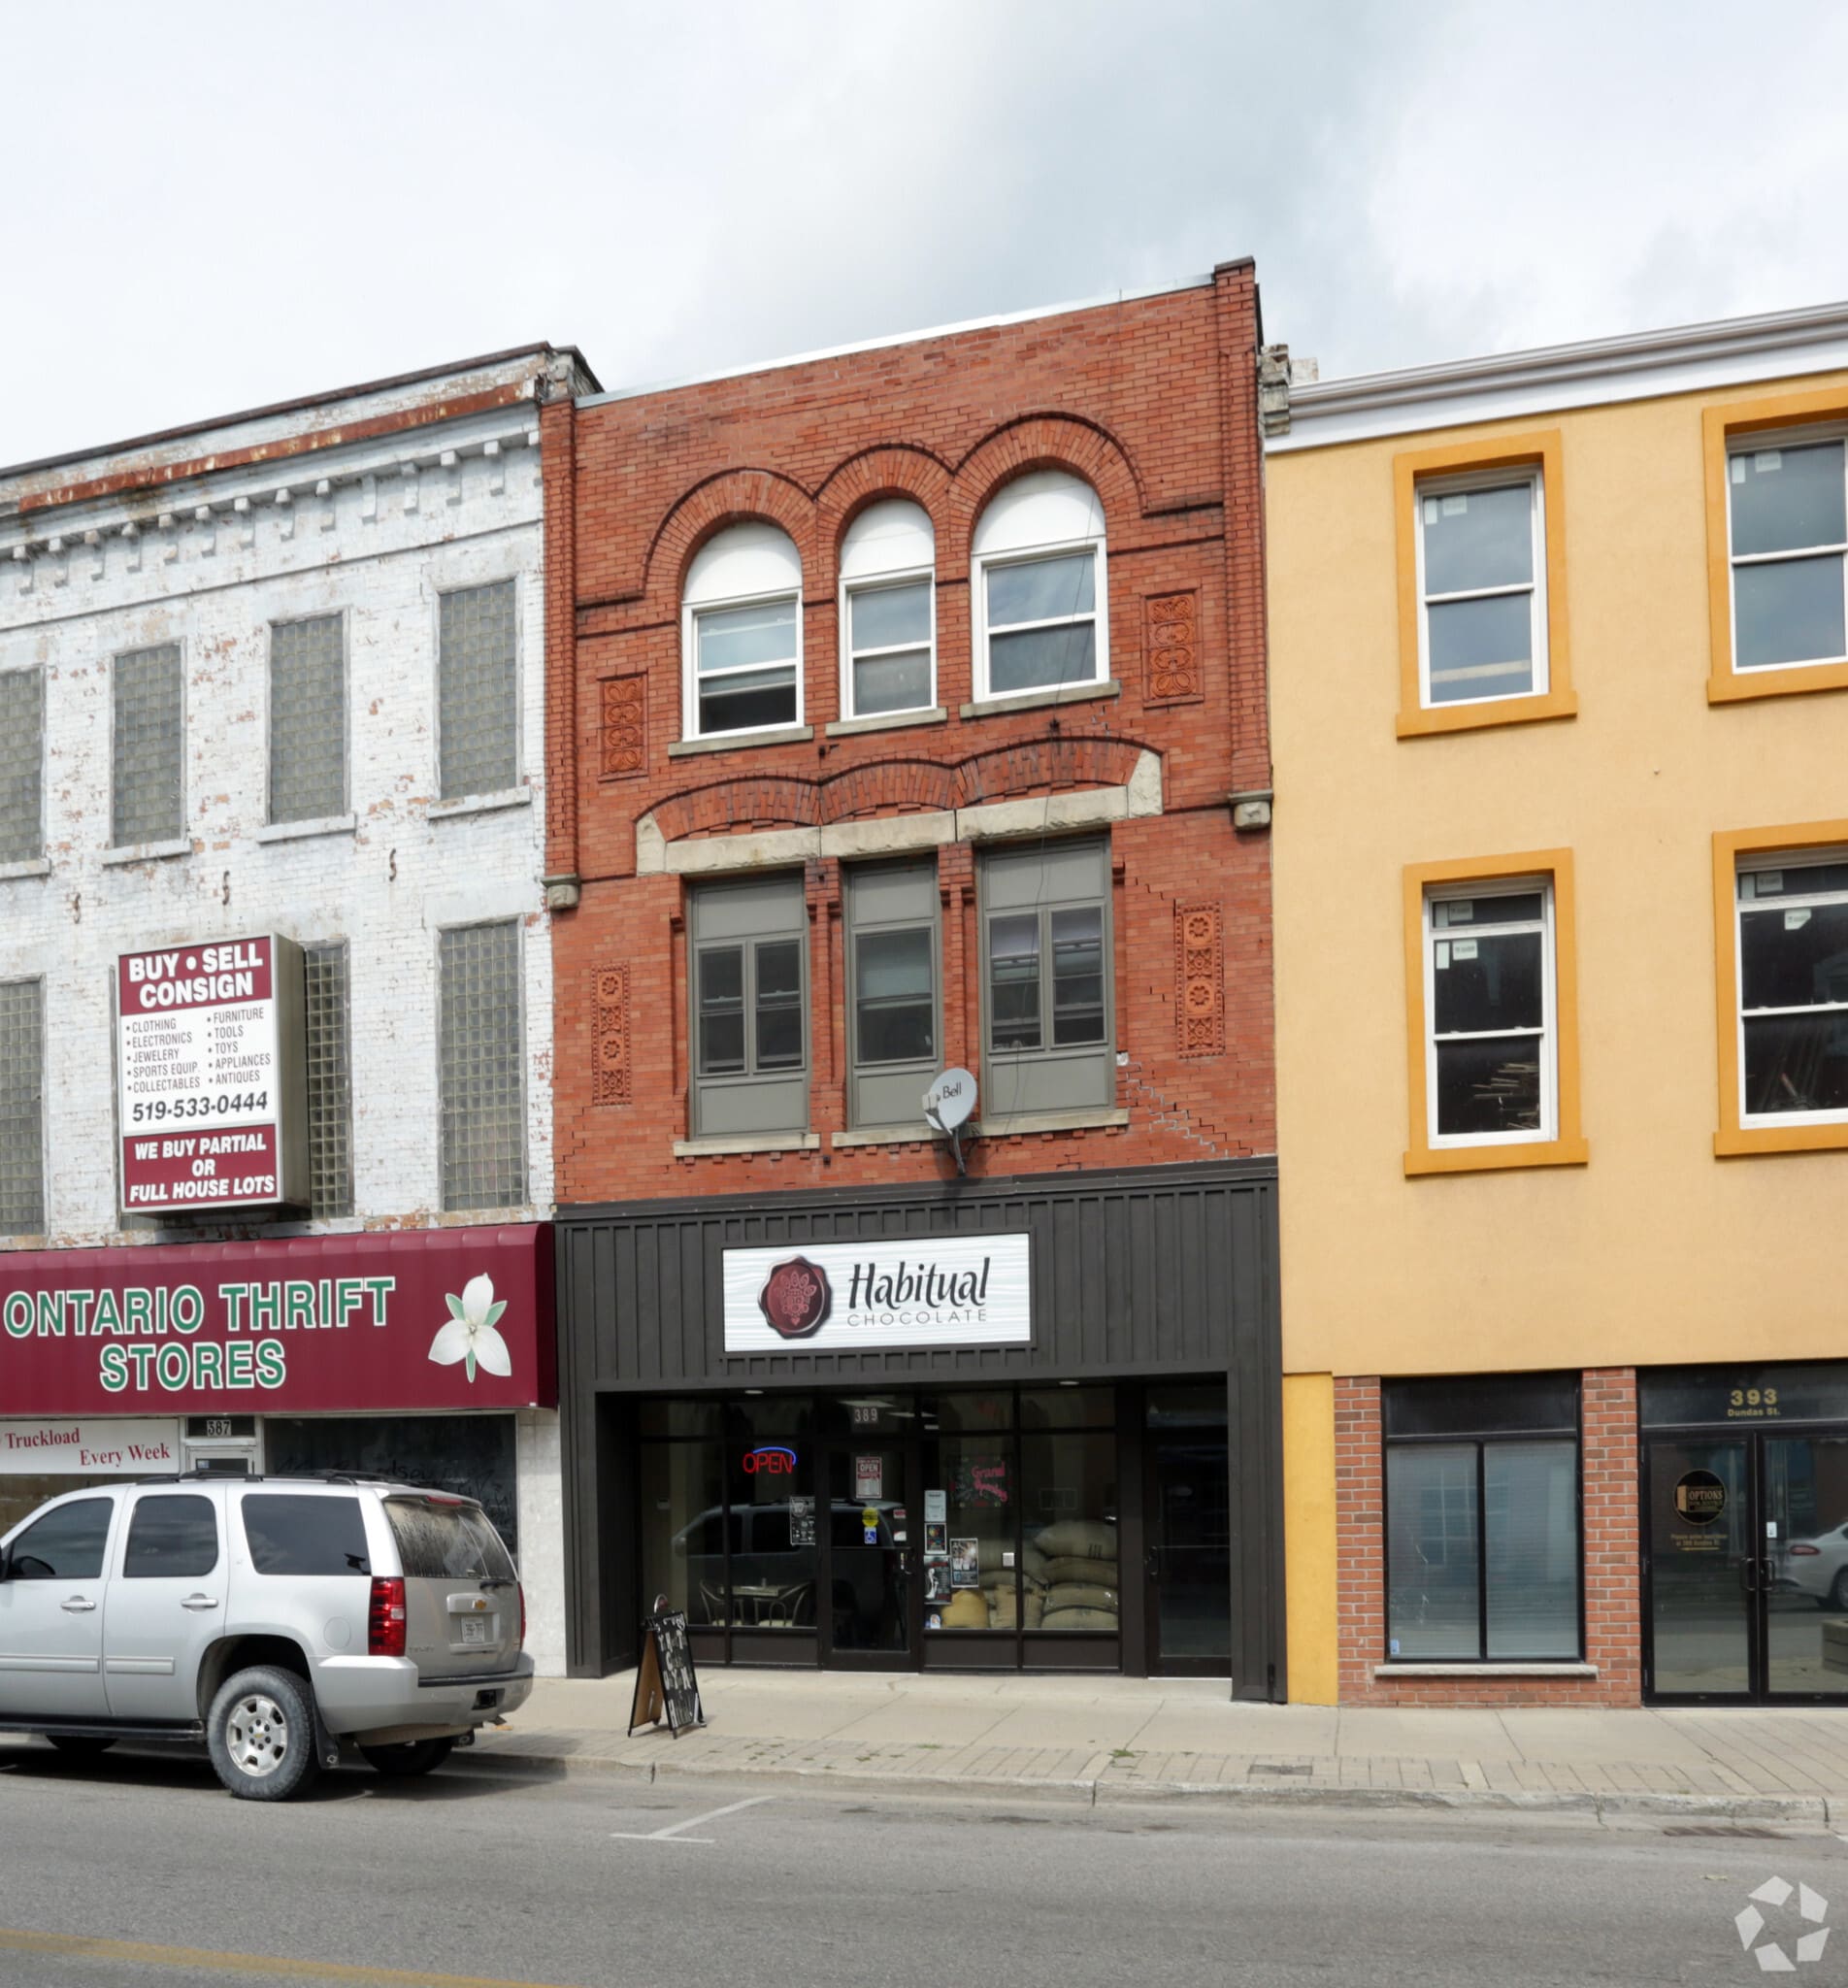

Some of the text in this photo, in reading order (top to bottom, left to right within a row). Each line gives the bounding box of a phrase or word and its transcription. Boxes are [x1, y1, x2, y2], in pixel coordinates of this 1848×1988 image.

[128, 943, 263, 982] BUY SELL
[139, 972, 253, 1009] CONSIGN
[214, 1007, 264, 1024] FURNITURE
[132, 1017, 177, 1034] CLOTHING
[214, 1025, 244, 1040] TOOLS
[132, 1031, 192, 1048] ELECTRONICS
[215, 1041, 239, 1054] TOYS
[133, 1048, 180, 1063] JEWELERY
[215, 1052, 271, 1070] APPLIANCES
[133, 1064, 168, 1078] SPORTS
[215, 1070, 260, 1085] ANTIQUES
[133, 1076, 200, 1093] COLLECTABLES
[942, 1080, 962, 1099] Bell
[132, 1090, 268, 1122] 519-533-0444
[135, 1133, 267, 1160] WE BUY PARTIAL
[192, 1158, 215, 1176] OR
[130, 1175, 275, 1203] FULL HOUSE LOTS
[848, 1256, 990, 1310] Habitual
[3, 1276, 396, 1339] ONTARIO THRIFT
[847, 1309, 987, 1327] CHOCOLATE
[100, 1339, 286, 1392] STORES
[1731, 1388, 1777, 1407] 393
[854, 1408, 877, 1422] 389
[1727, 1408, 1764, 1417] Dundas
[207, 1421, 231, 1437] 387
[5, 1428, 80, 1449] Truckload
[80, 1442, 171, 1468] Every Week
[742, 1452, 793, 1474] OPEN
[860, 1463, 878, 1473] OPEN
[1689, 1490, 1723, 1501] OPTIONS
